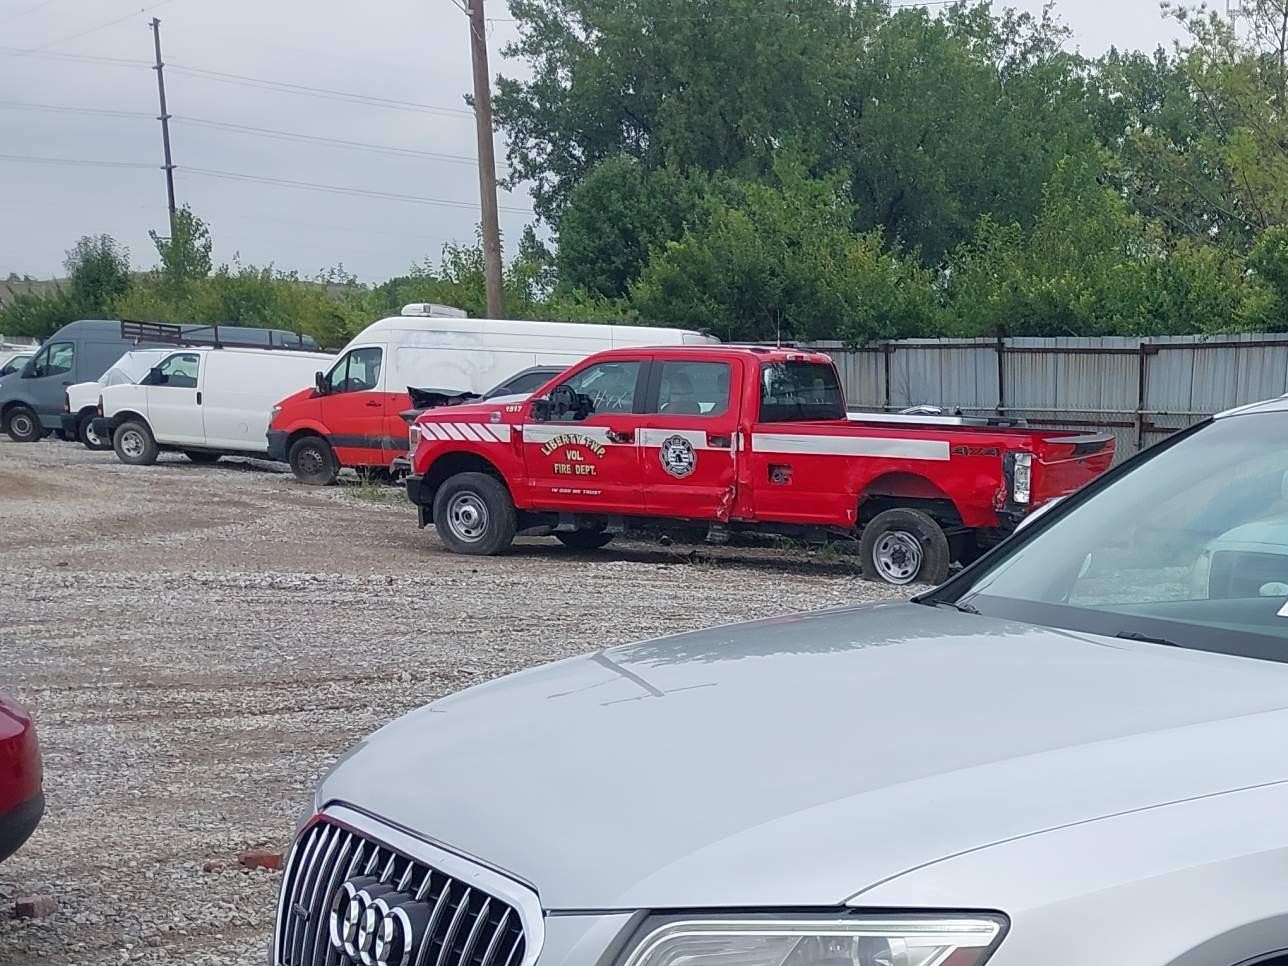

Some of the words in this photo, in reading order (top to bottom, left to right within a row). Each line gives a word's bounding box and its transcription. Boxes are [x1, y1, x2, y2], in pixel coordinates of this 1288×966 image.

[541, 434, 583, 456] LIBERTY
[585, 437, 606, 459] TWP.
[566, 450, 584, 461] VOL.
[554, 463, 572, 475] FIRE
[575, 464, 597, 476] DEPT.
